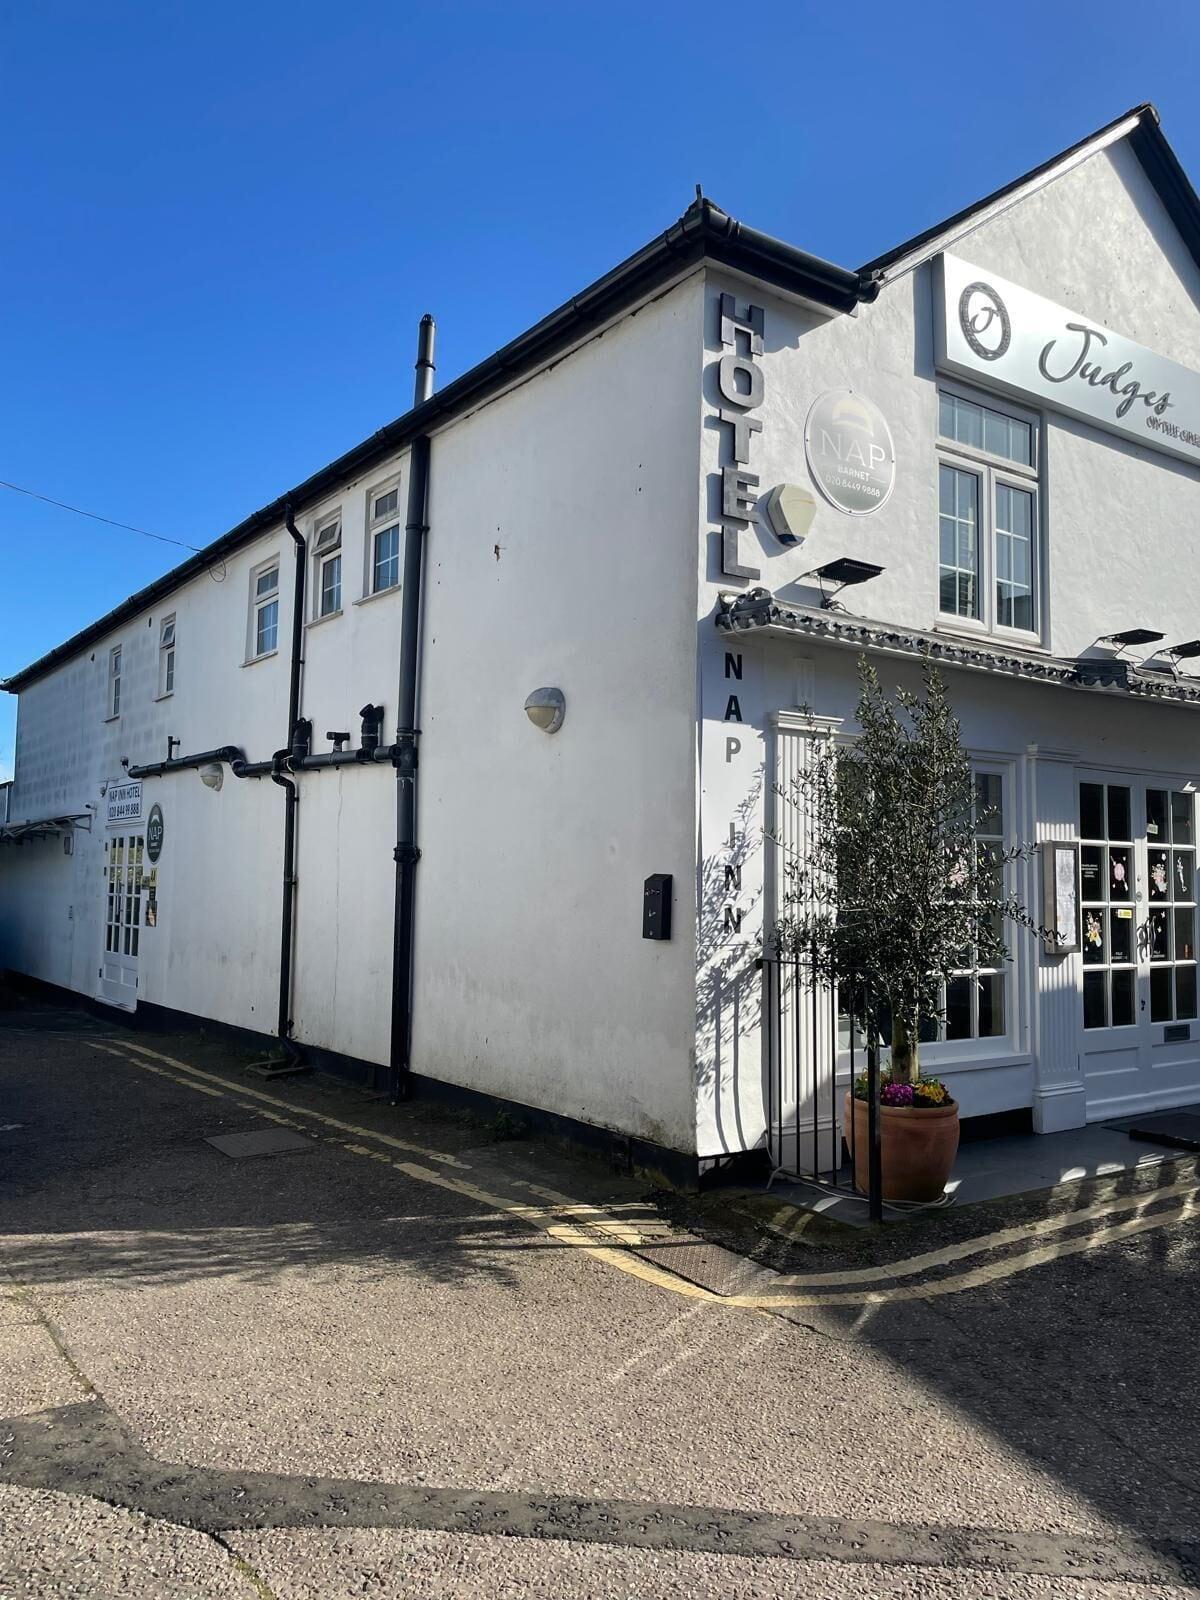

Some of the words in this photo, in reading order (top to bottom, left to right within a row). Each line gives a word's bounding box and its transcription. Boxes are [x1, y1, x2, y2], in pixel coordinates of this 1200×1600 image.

[1039, 323, 1175, 418] Judges
[720, 292, 764, 580] HOTEL
[821, 429, 885, 470] NAP
[839, 466, 870, 481] BARNET
[842, 479, 860, 490] 8449
[863, 486, 880, 497] 9888
[724, 652, 743, 764] NAP
[109, 788, 117, 803] NAP
[127, 786, 140, 800] HOTEL
[149, 825, 162, 840] NAP
